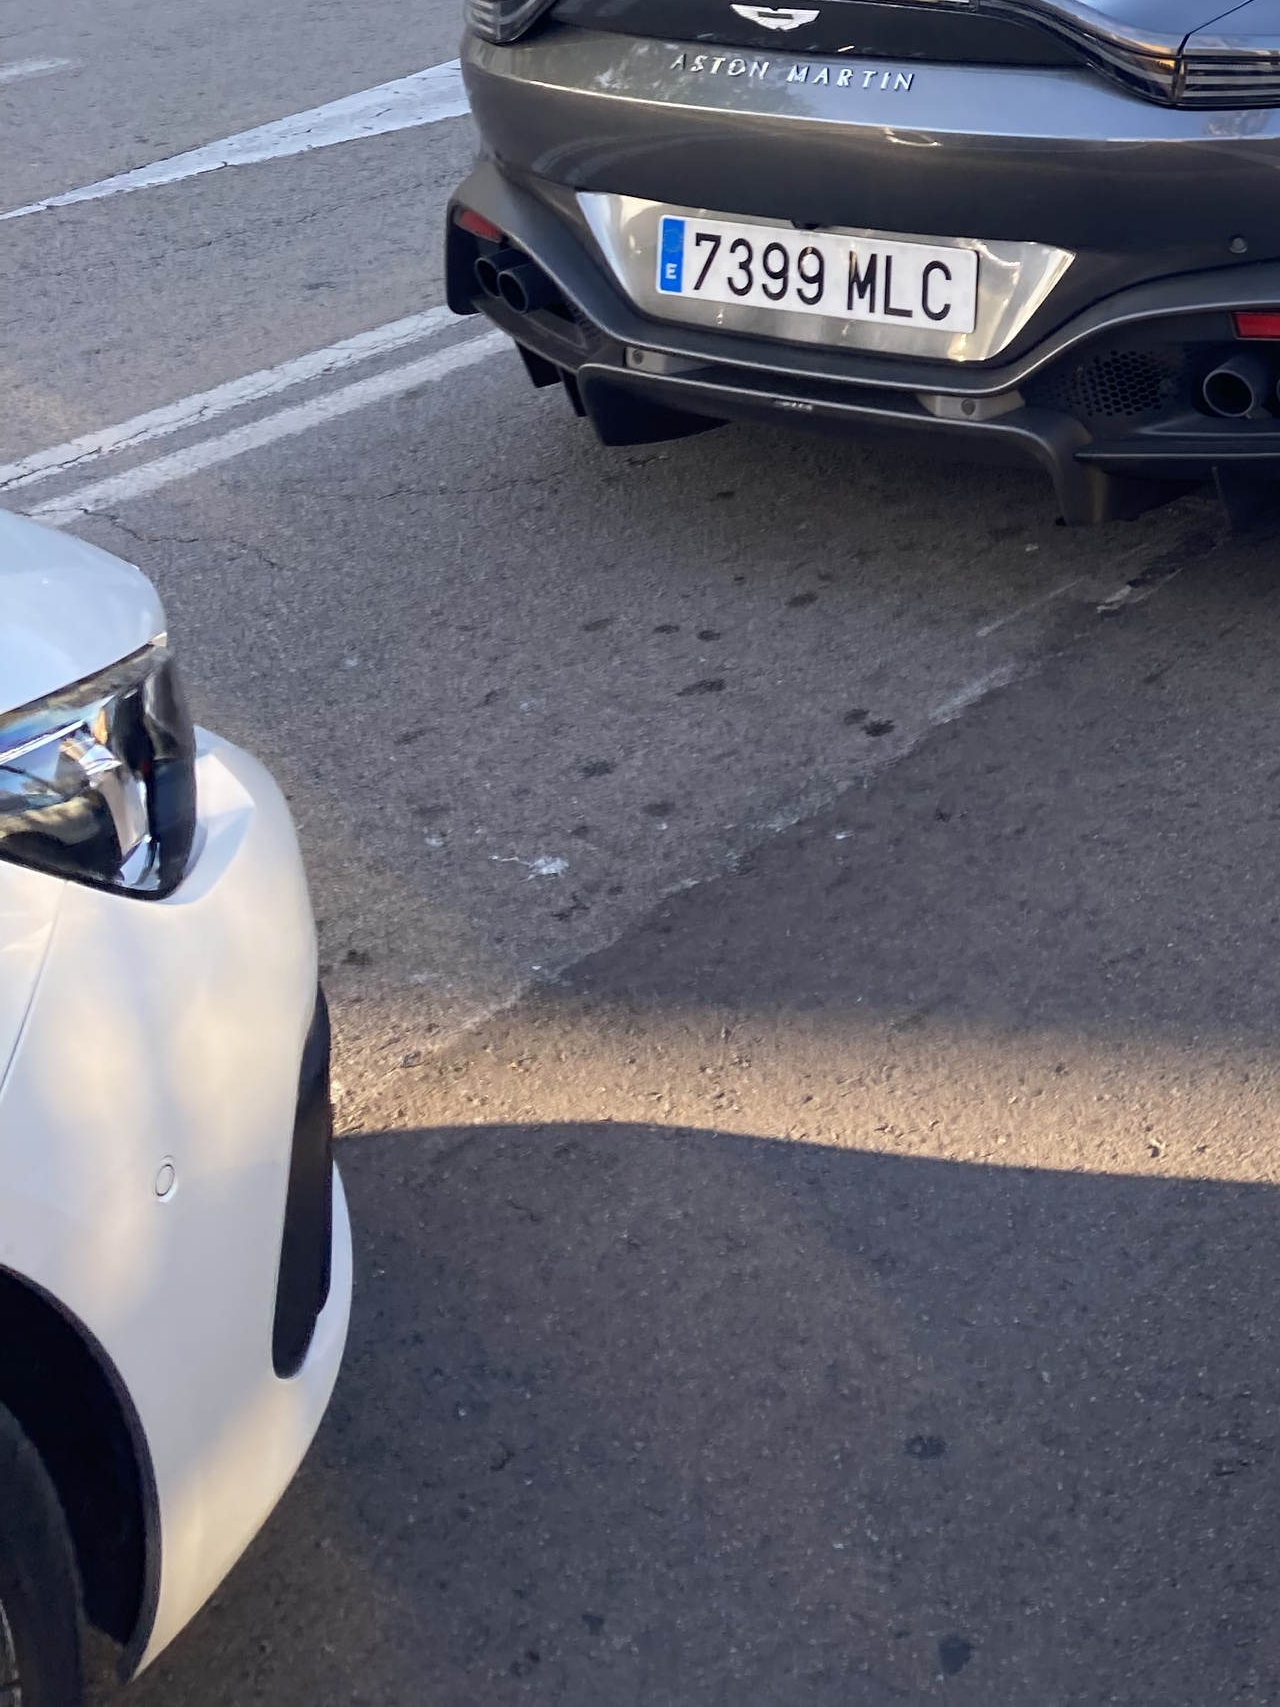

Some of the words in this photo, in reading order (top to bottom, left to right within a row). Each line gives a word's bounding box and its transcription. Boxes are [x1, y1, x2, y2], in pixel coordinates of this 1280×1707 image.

[669, 53, 770, 81] ASTON
[786, 64, 915, 92] MARTIN
[692, 232, 826, 306] 7399
[846, 248, 953, 322] MLC
